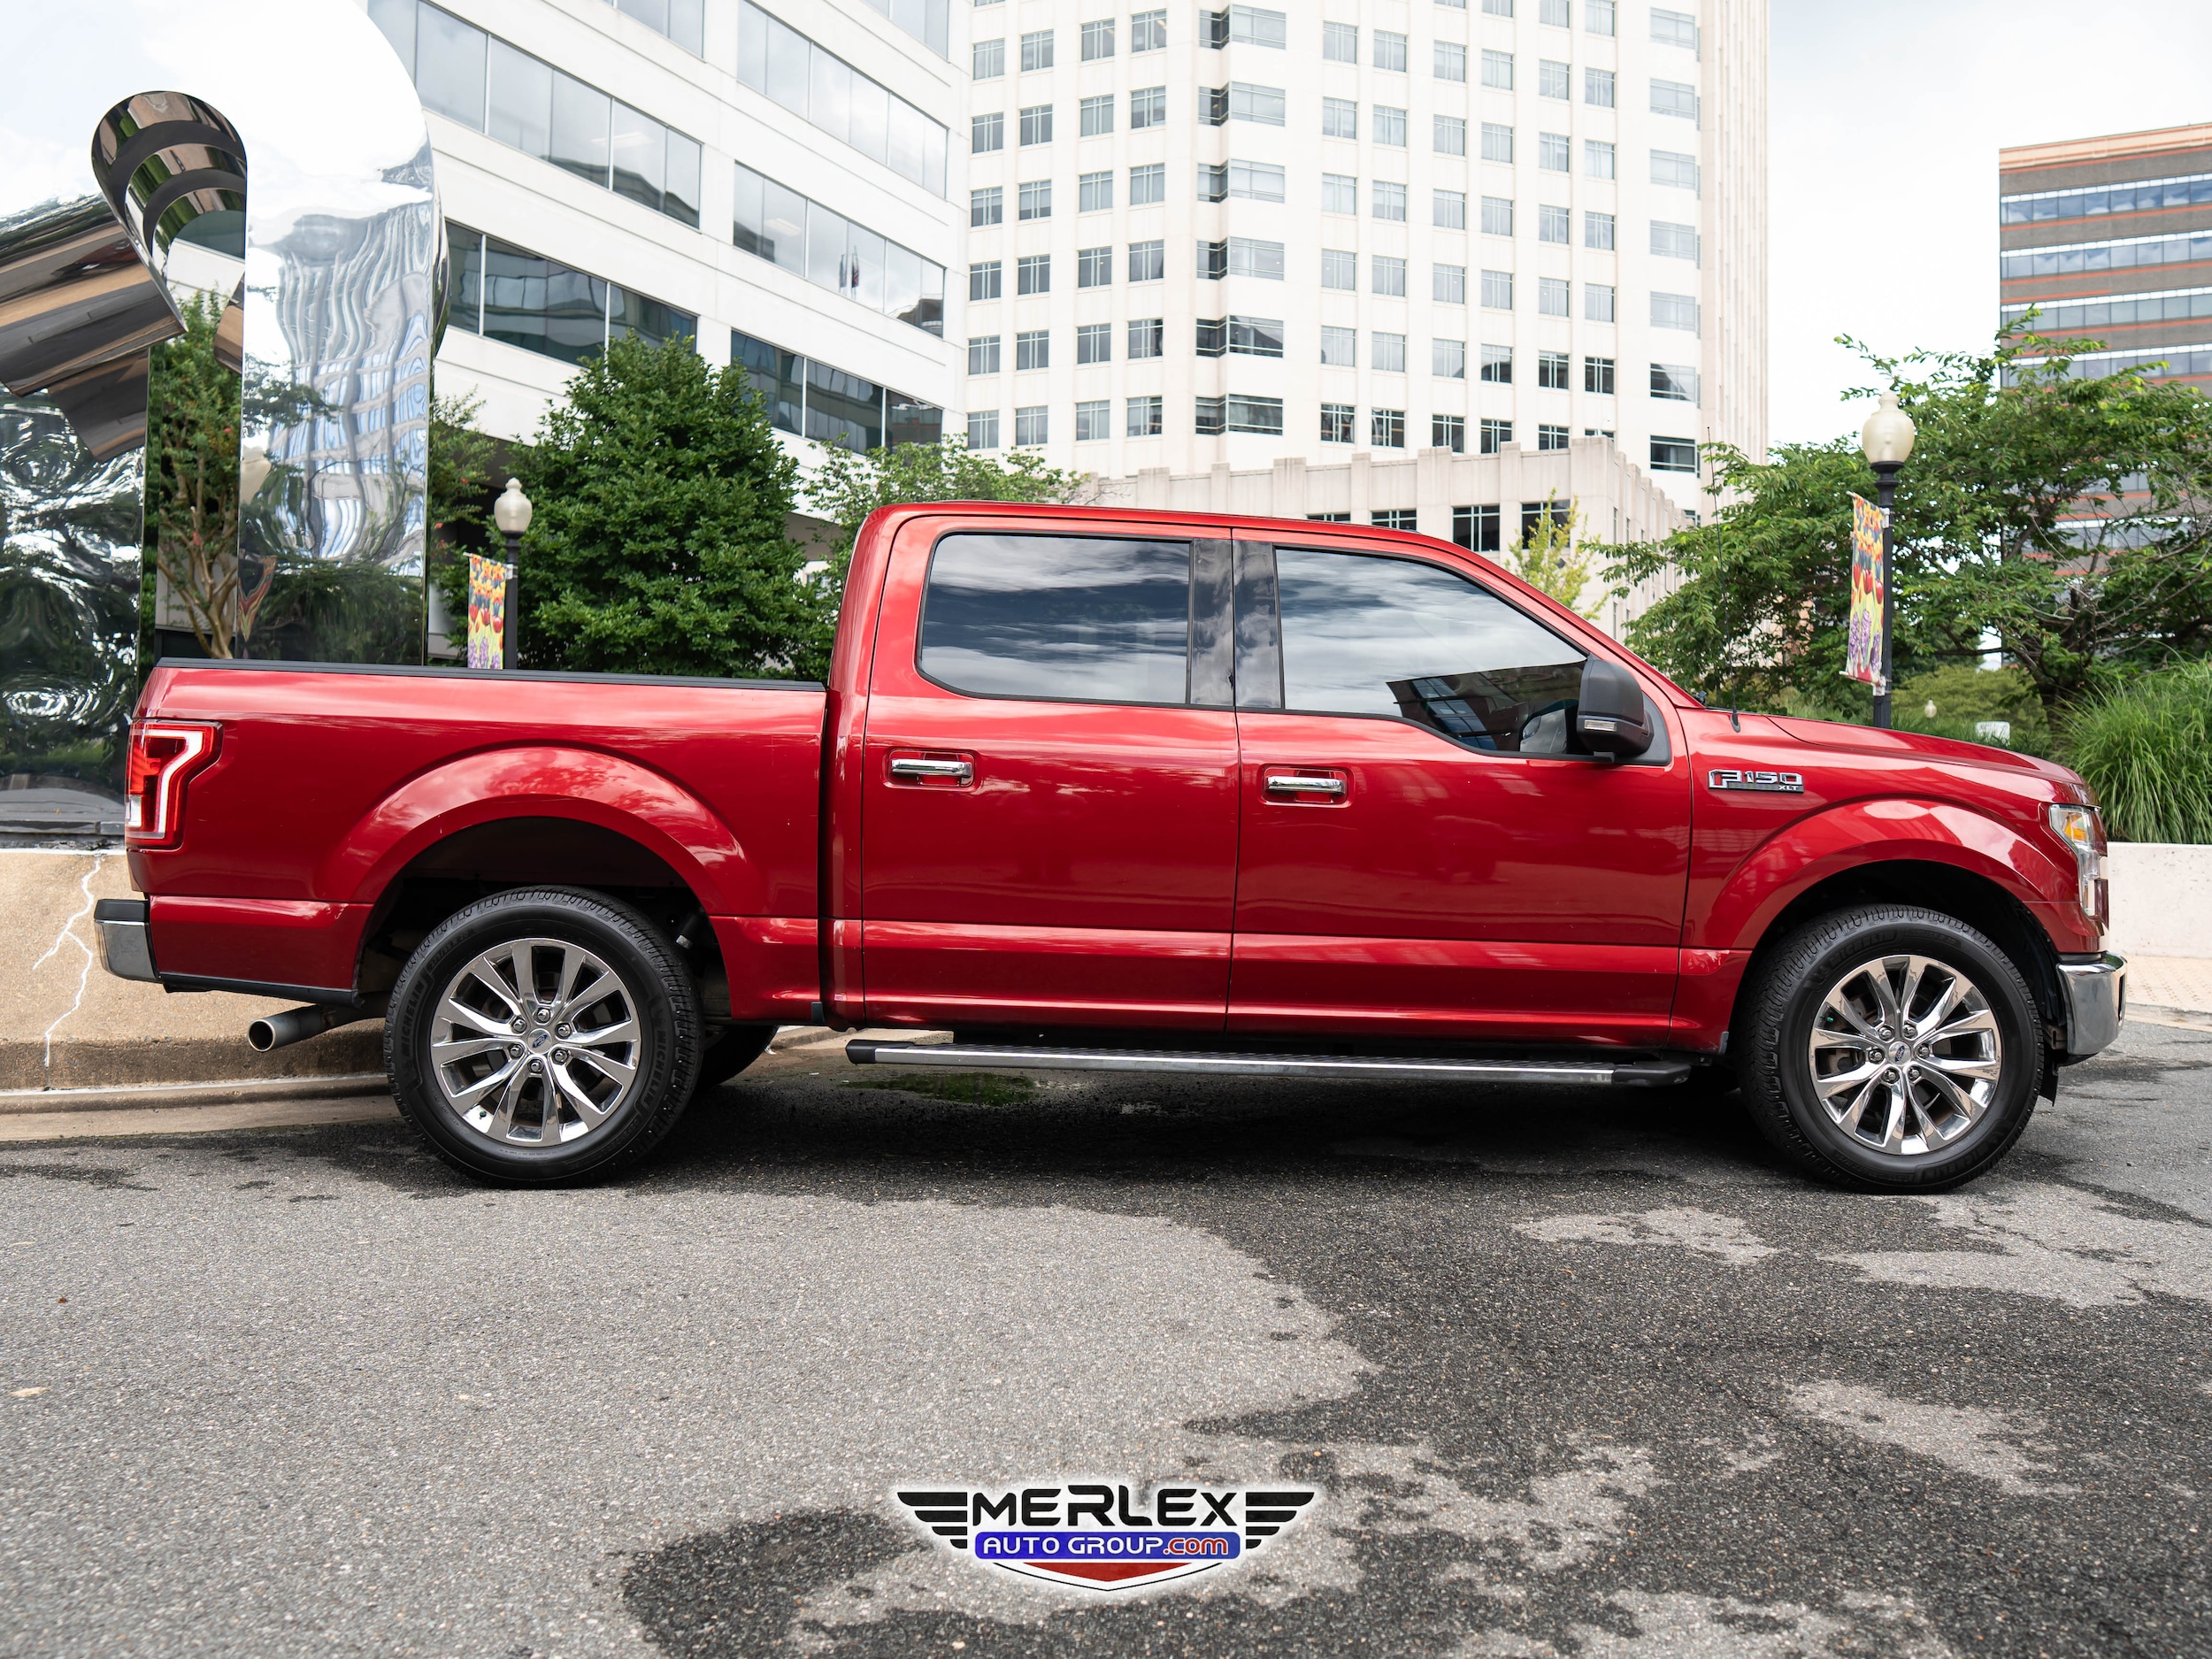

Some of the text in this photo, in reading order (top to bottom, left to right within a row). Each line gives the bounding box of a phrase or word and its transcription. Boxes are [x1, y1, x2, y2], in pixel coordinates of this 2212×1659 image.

[1828, 931, 1895, 965] MICHELIN
[402, 979, 425, 1057] MICHELIN
[644, 1030, 667, 1107] MICHELIN
